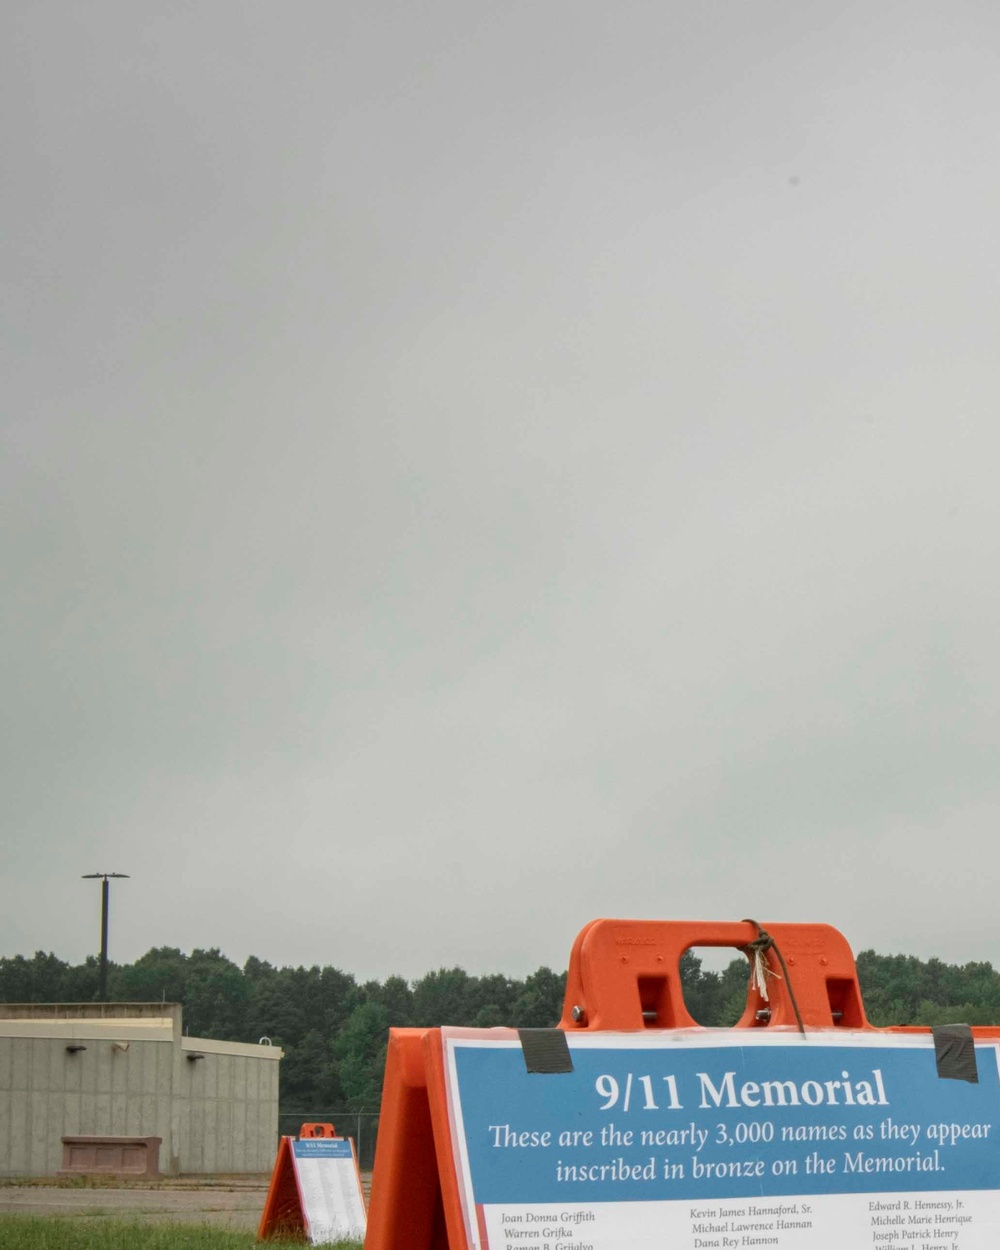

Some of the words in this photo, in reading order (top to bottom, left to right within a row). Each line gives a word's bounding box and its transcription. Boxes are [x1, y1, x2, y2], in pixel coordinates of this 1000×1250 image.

[595, 1073, 684, 1112] 9/11
[696, 1069, 890, 1108] Memorial
[489, 1124, 551, 1147] These
[559, 1132, 593, 1147] are
[601, 1124, 633, 1146] the
[641, 1122, 708, 1151] nearly
[716, 1122, 774, 1146] 3,000
[782, 1126, 847, 1141] names
[854, 1125, 874, 1140] as
[880, 1118, 921, 1145] they
[927, 1123, 991, 1146] appear
[557, 1157, 656, 1181] inscribed
[664, 1159, 684, 1179] in
[692, 1156, 765, 1178] bronze
[772, 1160, 797, 1175] on
[805, 1152, 836, 1174] the
[844, 1150, 945, 1173] Memorial.
[501, 1212, 522, 1224] Joan
[525, 1212, 558, 1222] Donna
[560, 1210, 595, 1224] Griffith
[690, 1208, 716, 1218] Kevin
[718, 1207, 745, 1218] James
[748, 1203, 799, 1217] Hannaford,
[801, 1203, 812, 1213] Sr.
[870, 1214, 905, 1226] Michelle
[907, 1215, 932, 1224] Marie
[934, 1213, 972, 1226] Henrique
